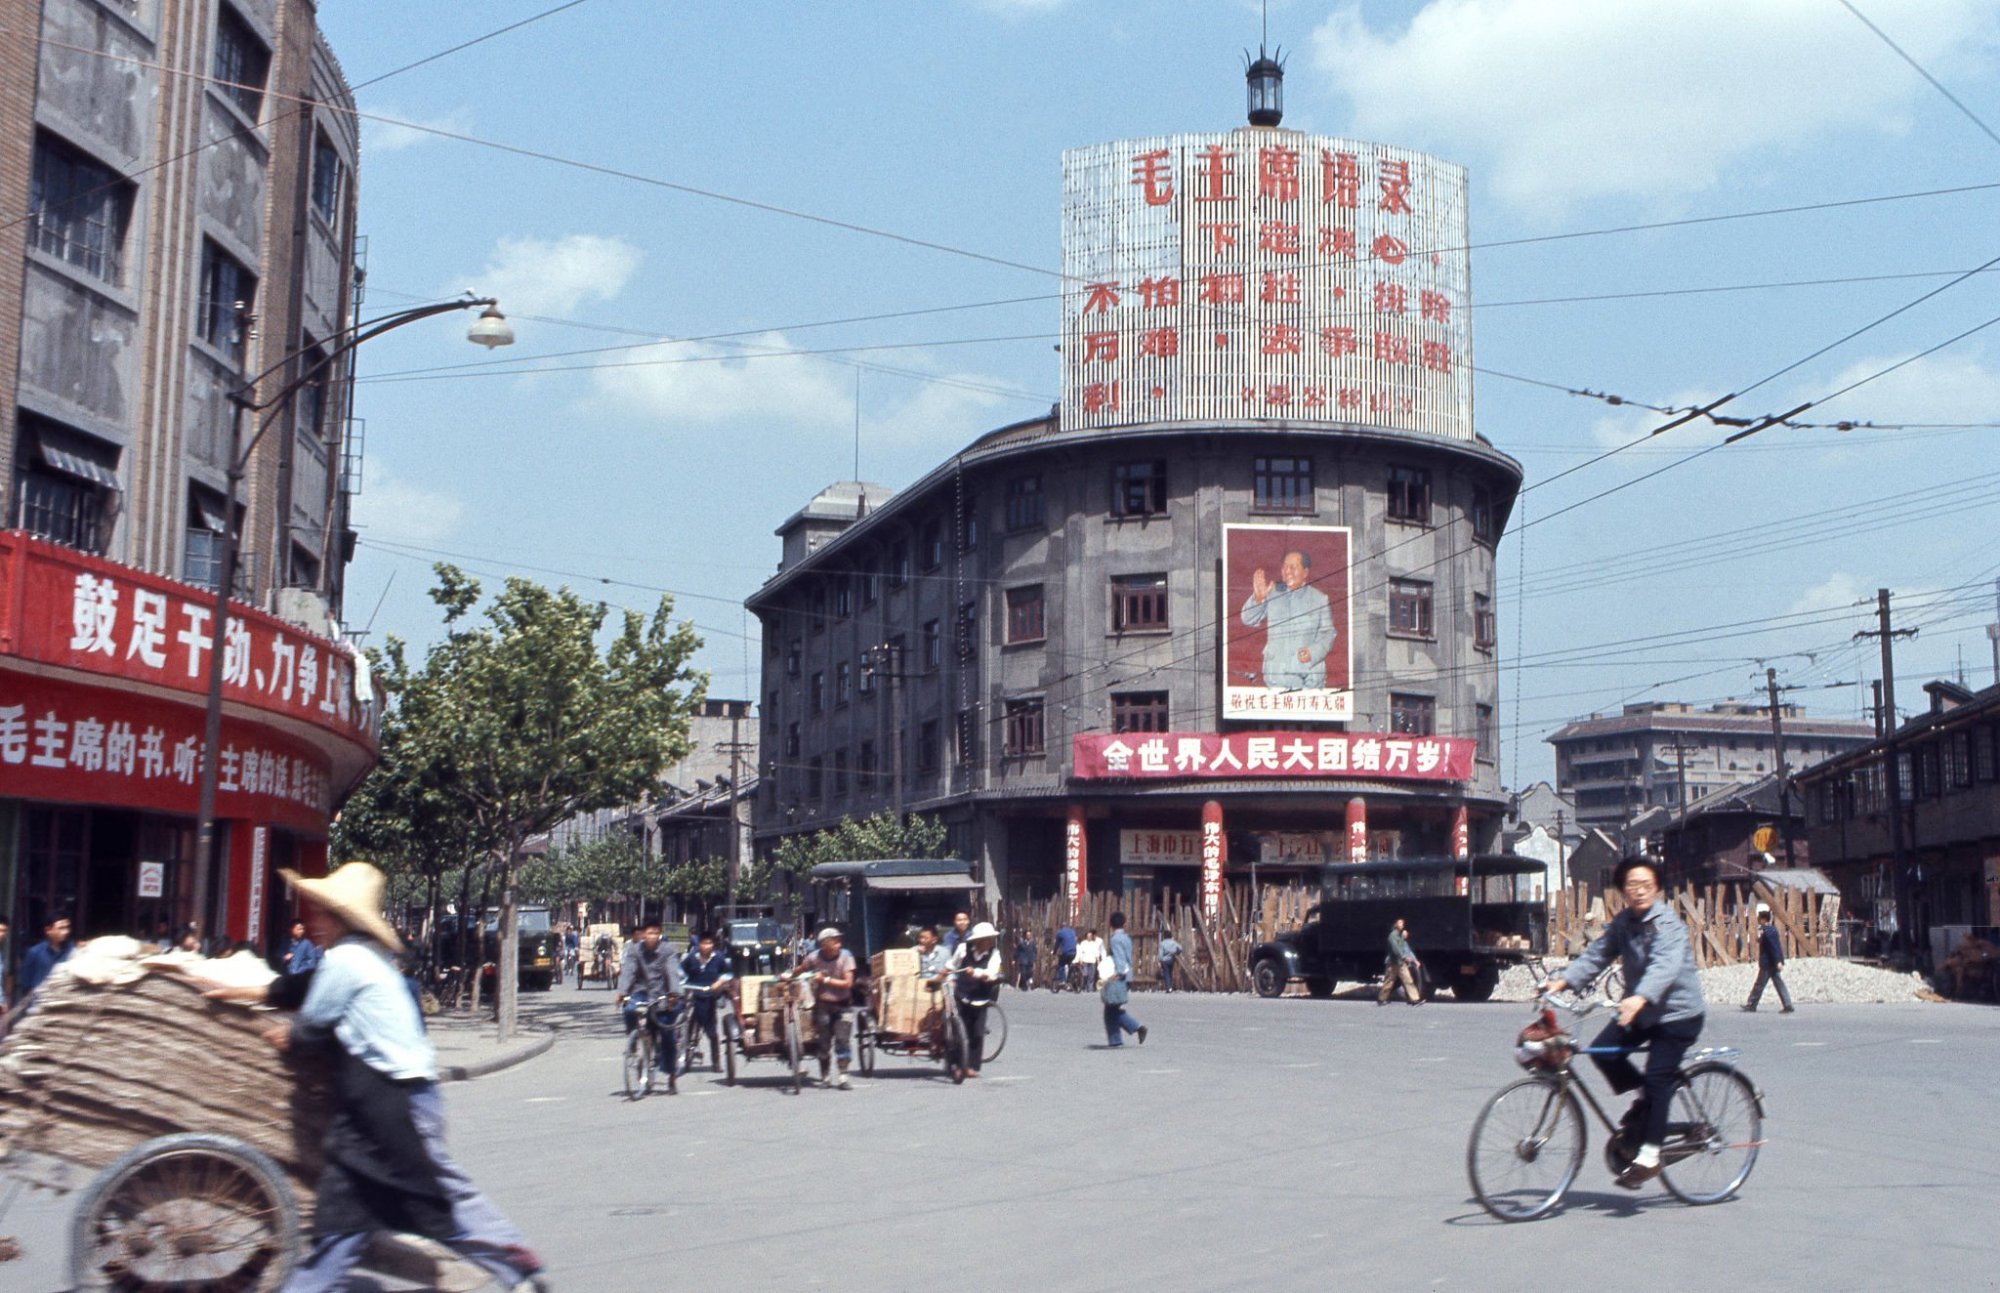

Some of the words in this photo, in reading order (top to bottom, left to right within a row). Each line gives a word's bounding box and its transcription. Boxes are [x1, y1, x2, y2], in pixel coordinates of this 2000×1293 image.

[1131, 144, 1412, 216] 毛主席语录
[1231, 693, 1345, 711] 敬祝毛主席万寿无疆
